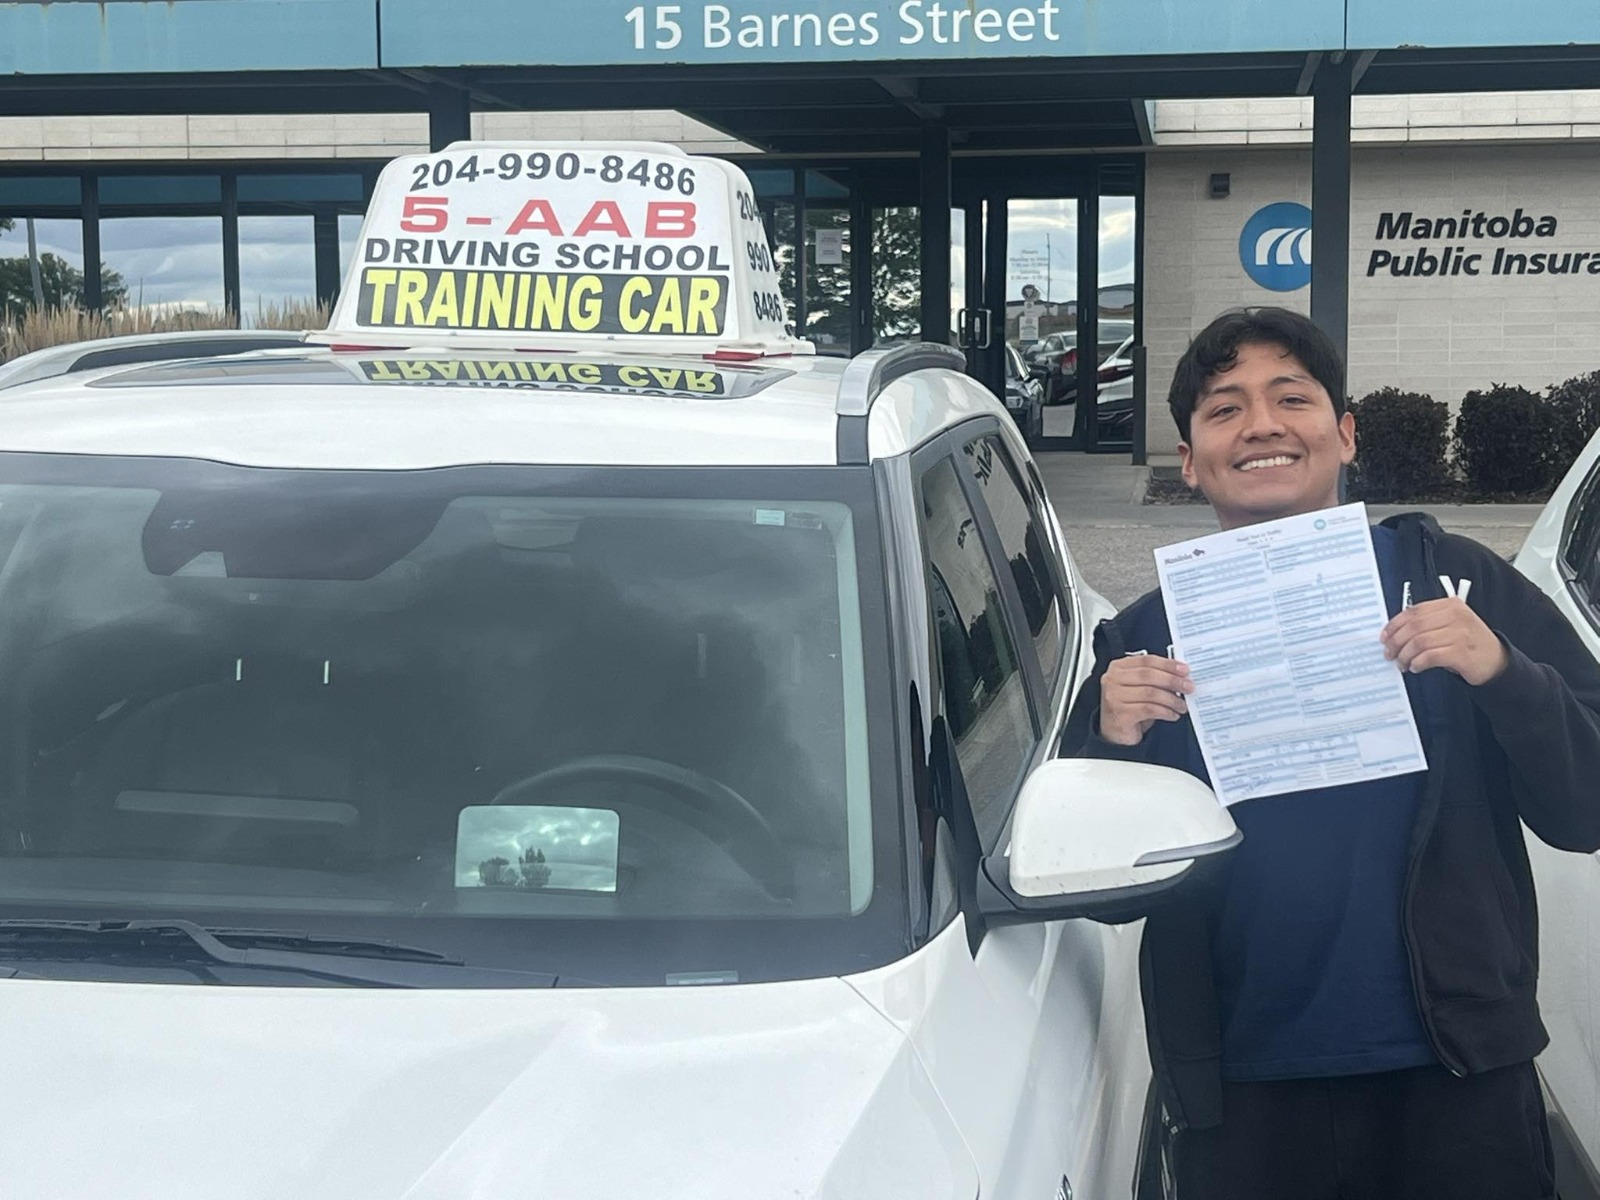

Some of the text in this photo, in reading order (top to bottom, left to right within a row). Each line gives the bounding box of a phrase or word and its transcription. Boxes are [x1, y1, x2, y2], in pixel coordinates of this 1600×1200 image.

[624, 0, 1060, 50] 15 Barnes Street
[410, 152, 696, 197] 204-990-8486
[400, 196, 698, 238] 5-AAB
[1375, 208, 1558, 240] Manitoba
[364, 238, 731, 271] DRIVING SCHOOL
[747, 241, 770, 273] 990
[1367, 246, 1482, 277] Public
[365, 269, 721, 334] TRAINING CAR
[753, 291, 783, 323] 8486
